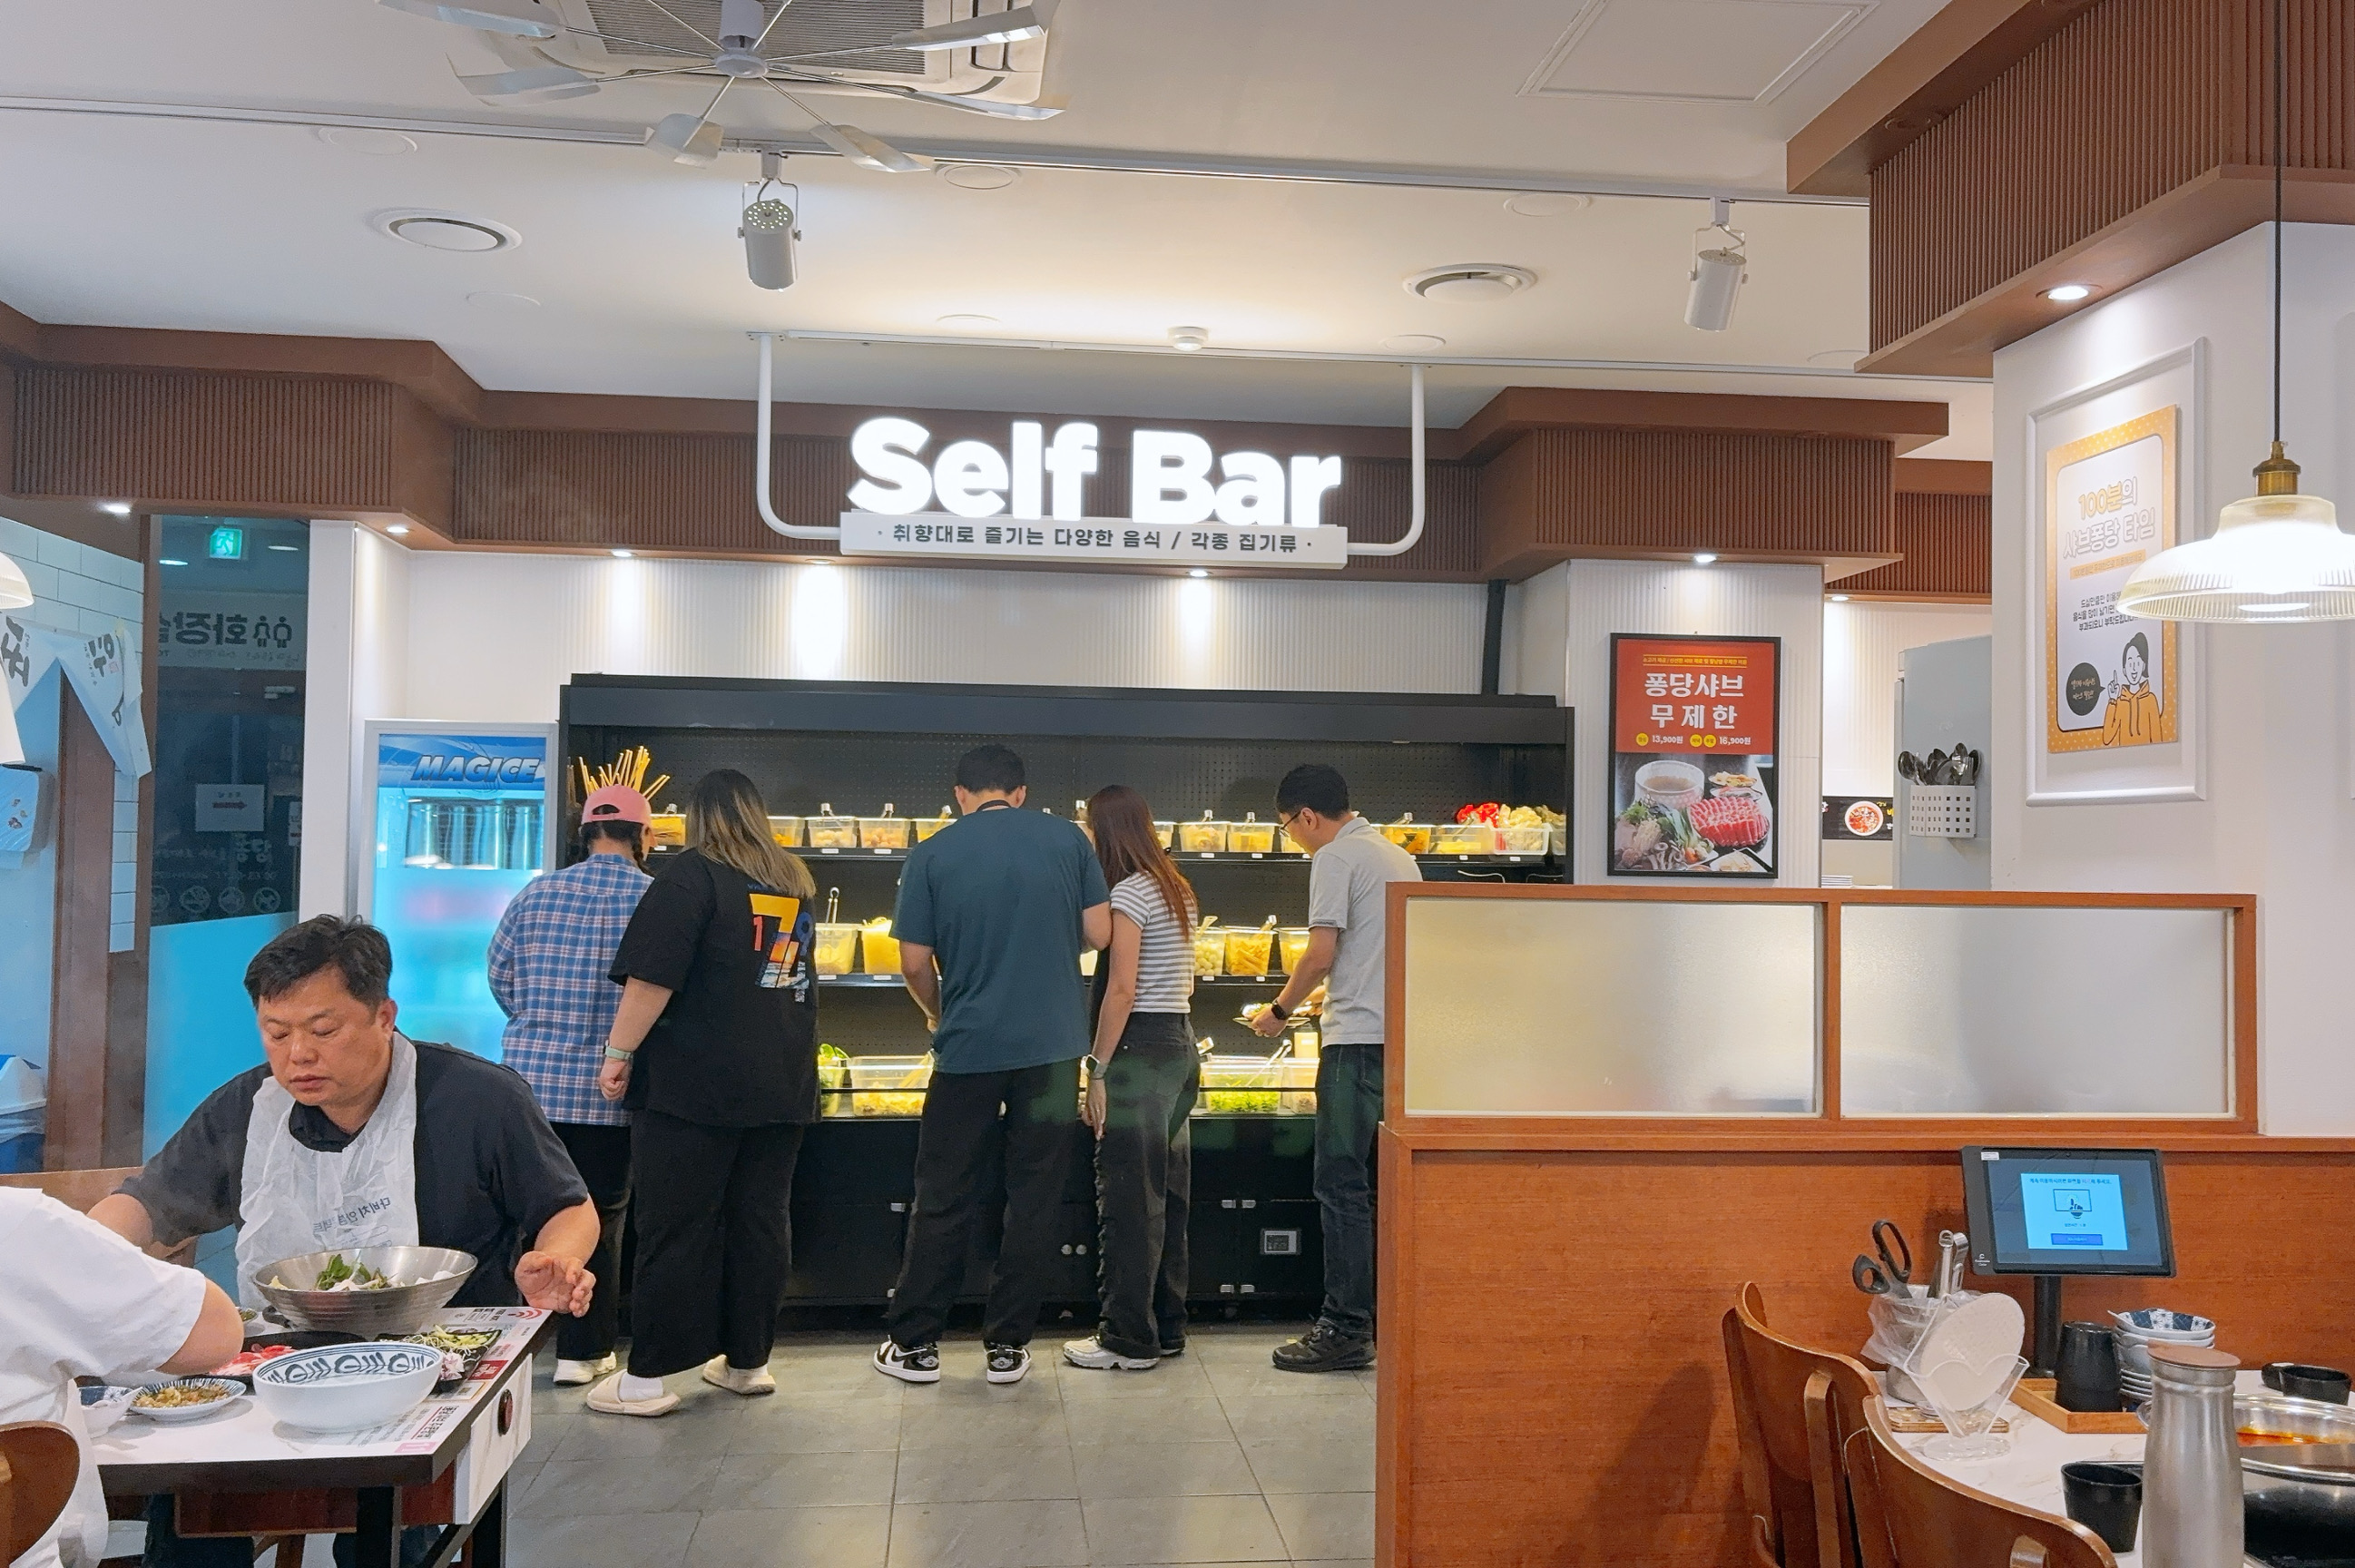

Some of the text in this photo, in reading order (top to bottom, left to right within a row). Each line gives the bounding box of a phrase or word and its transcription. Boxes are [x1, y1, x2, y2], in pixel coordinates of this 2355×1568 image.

[847, 416, 1342, 528] Self Bar
[2078, 475, 2137, 521] 100분의
[893, 524, 975, 544] 취향대로
[985, 526, 1045, 546] 즐기는
[1054, 527, 1114, 547] 다양한
[1123, 529, 1161, 549] 음식
[1190, 531, 1229, 551] 각종
[1238, 533, 1297, 553] 집기류
[2062, 506, 2156, 560] 샤브퐁당 타임
[1644, 672, 1744, 698] 퐁당샤브
[1652, 735, 1683, 745] 13,900원
[410, 755, 541, 784] MAGICE
